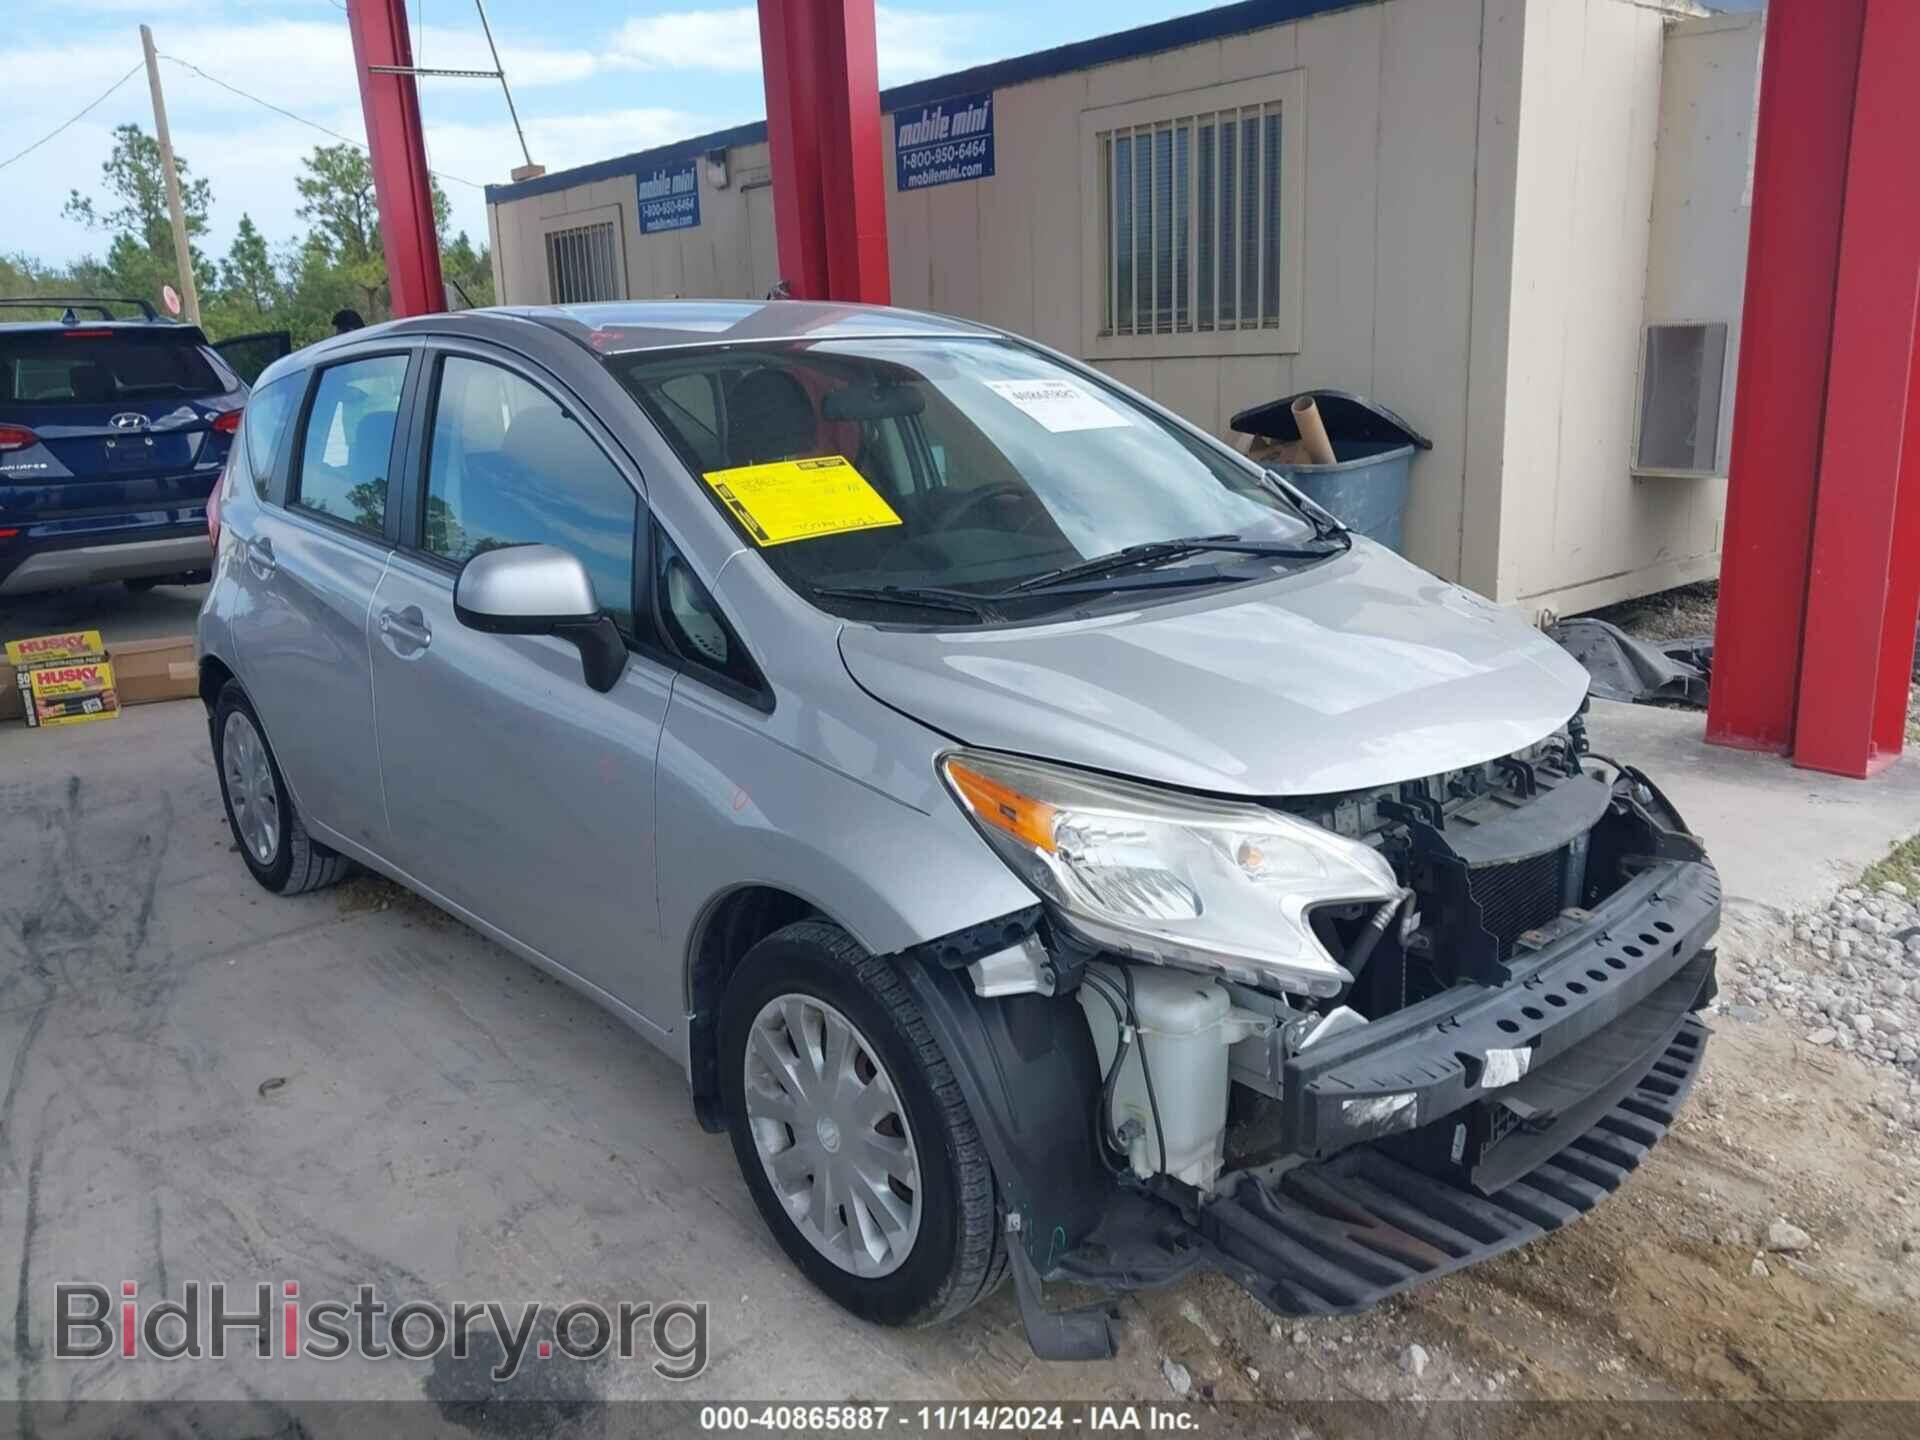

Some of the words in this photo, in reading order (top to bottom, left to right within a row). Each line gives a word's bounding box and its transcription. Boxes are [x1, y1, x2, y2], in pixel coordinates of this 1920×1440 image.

[899, 106, 950, 147] mobile
[951, 94, 991, 136] mini
[903, 138, 987, 170] 1-800-950-6464
[640, 169, 671, 200] mobile
[672, 167, 696, 194] mini
[908, 163, 982, 187] mobilemini.com
[17, 634, 85, 654] HUSKY
[17, 671, 30, 685] 50
[36, 666, 98, 685] HUSKY
